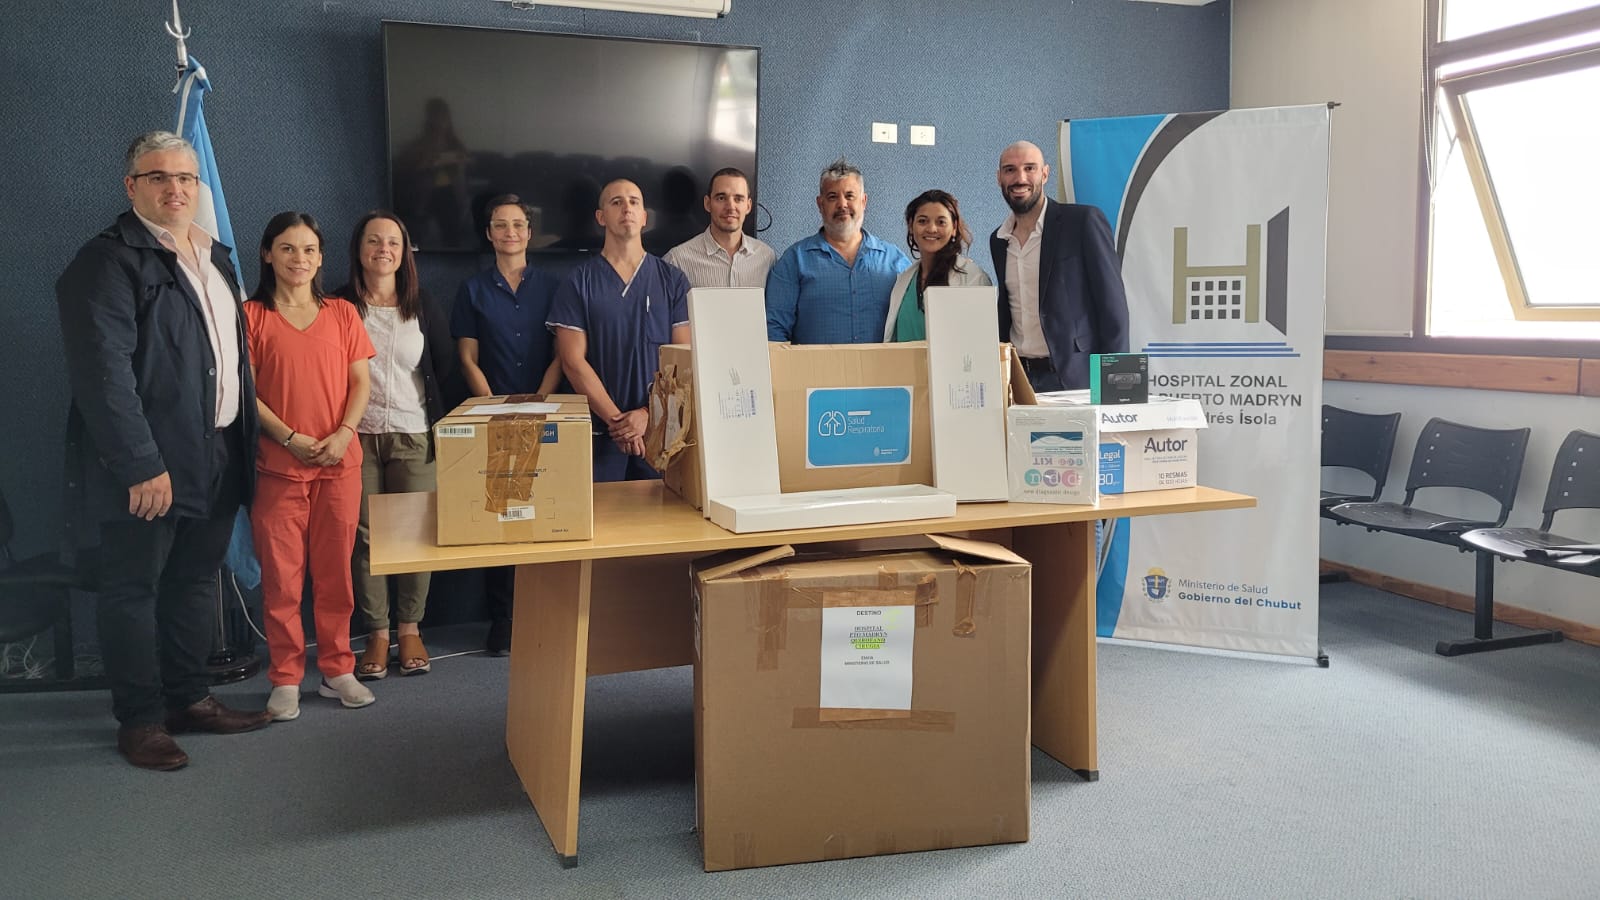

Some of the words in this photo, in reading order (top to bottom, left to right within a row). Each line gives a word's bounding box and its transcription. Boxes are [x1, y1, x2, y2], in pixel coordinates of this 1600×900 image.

[1230, 375, 1288, 387] ZONAL
[1158, 393, 1225, 406] RTO
[1229, 393, 1303, 407] MADRYN
[847, 416, 865, 425] Salud
[1101, 412, 1138, 424] Autor
[1204, 411, 1234, 425] rés
[1239, 409, 1277, 425] Ísola
[1143, 437, 1189, 453] Autor
[1099, 449, 1121, 461] Legal
[1178, 578, 1225, 591] Ministerio
[1227, 582, 1240, 592] de
[1241, 583, 1268, 595] Salud
[1178, 591, 1231, 604] Gobierno
[1234, 595, 1252, 606] del
[1256, 598, 1302, 610] Chubut
